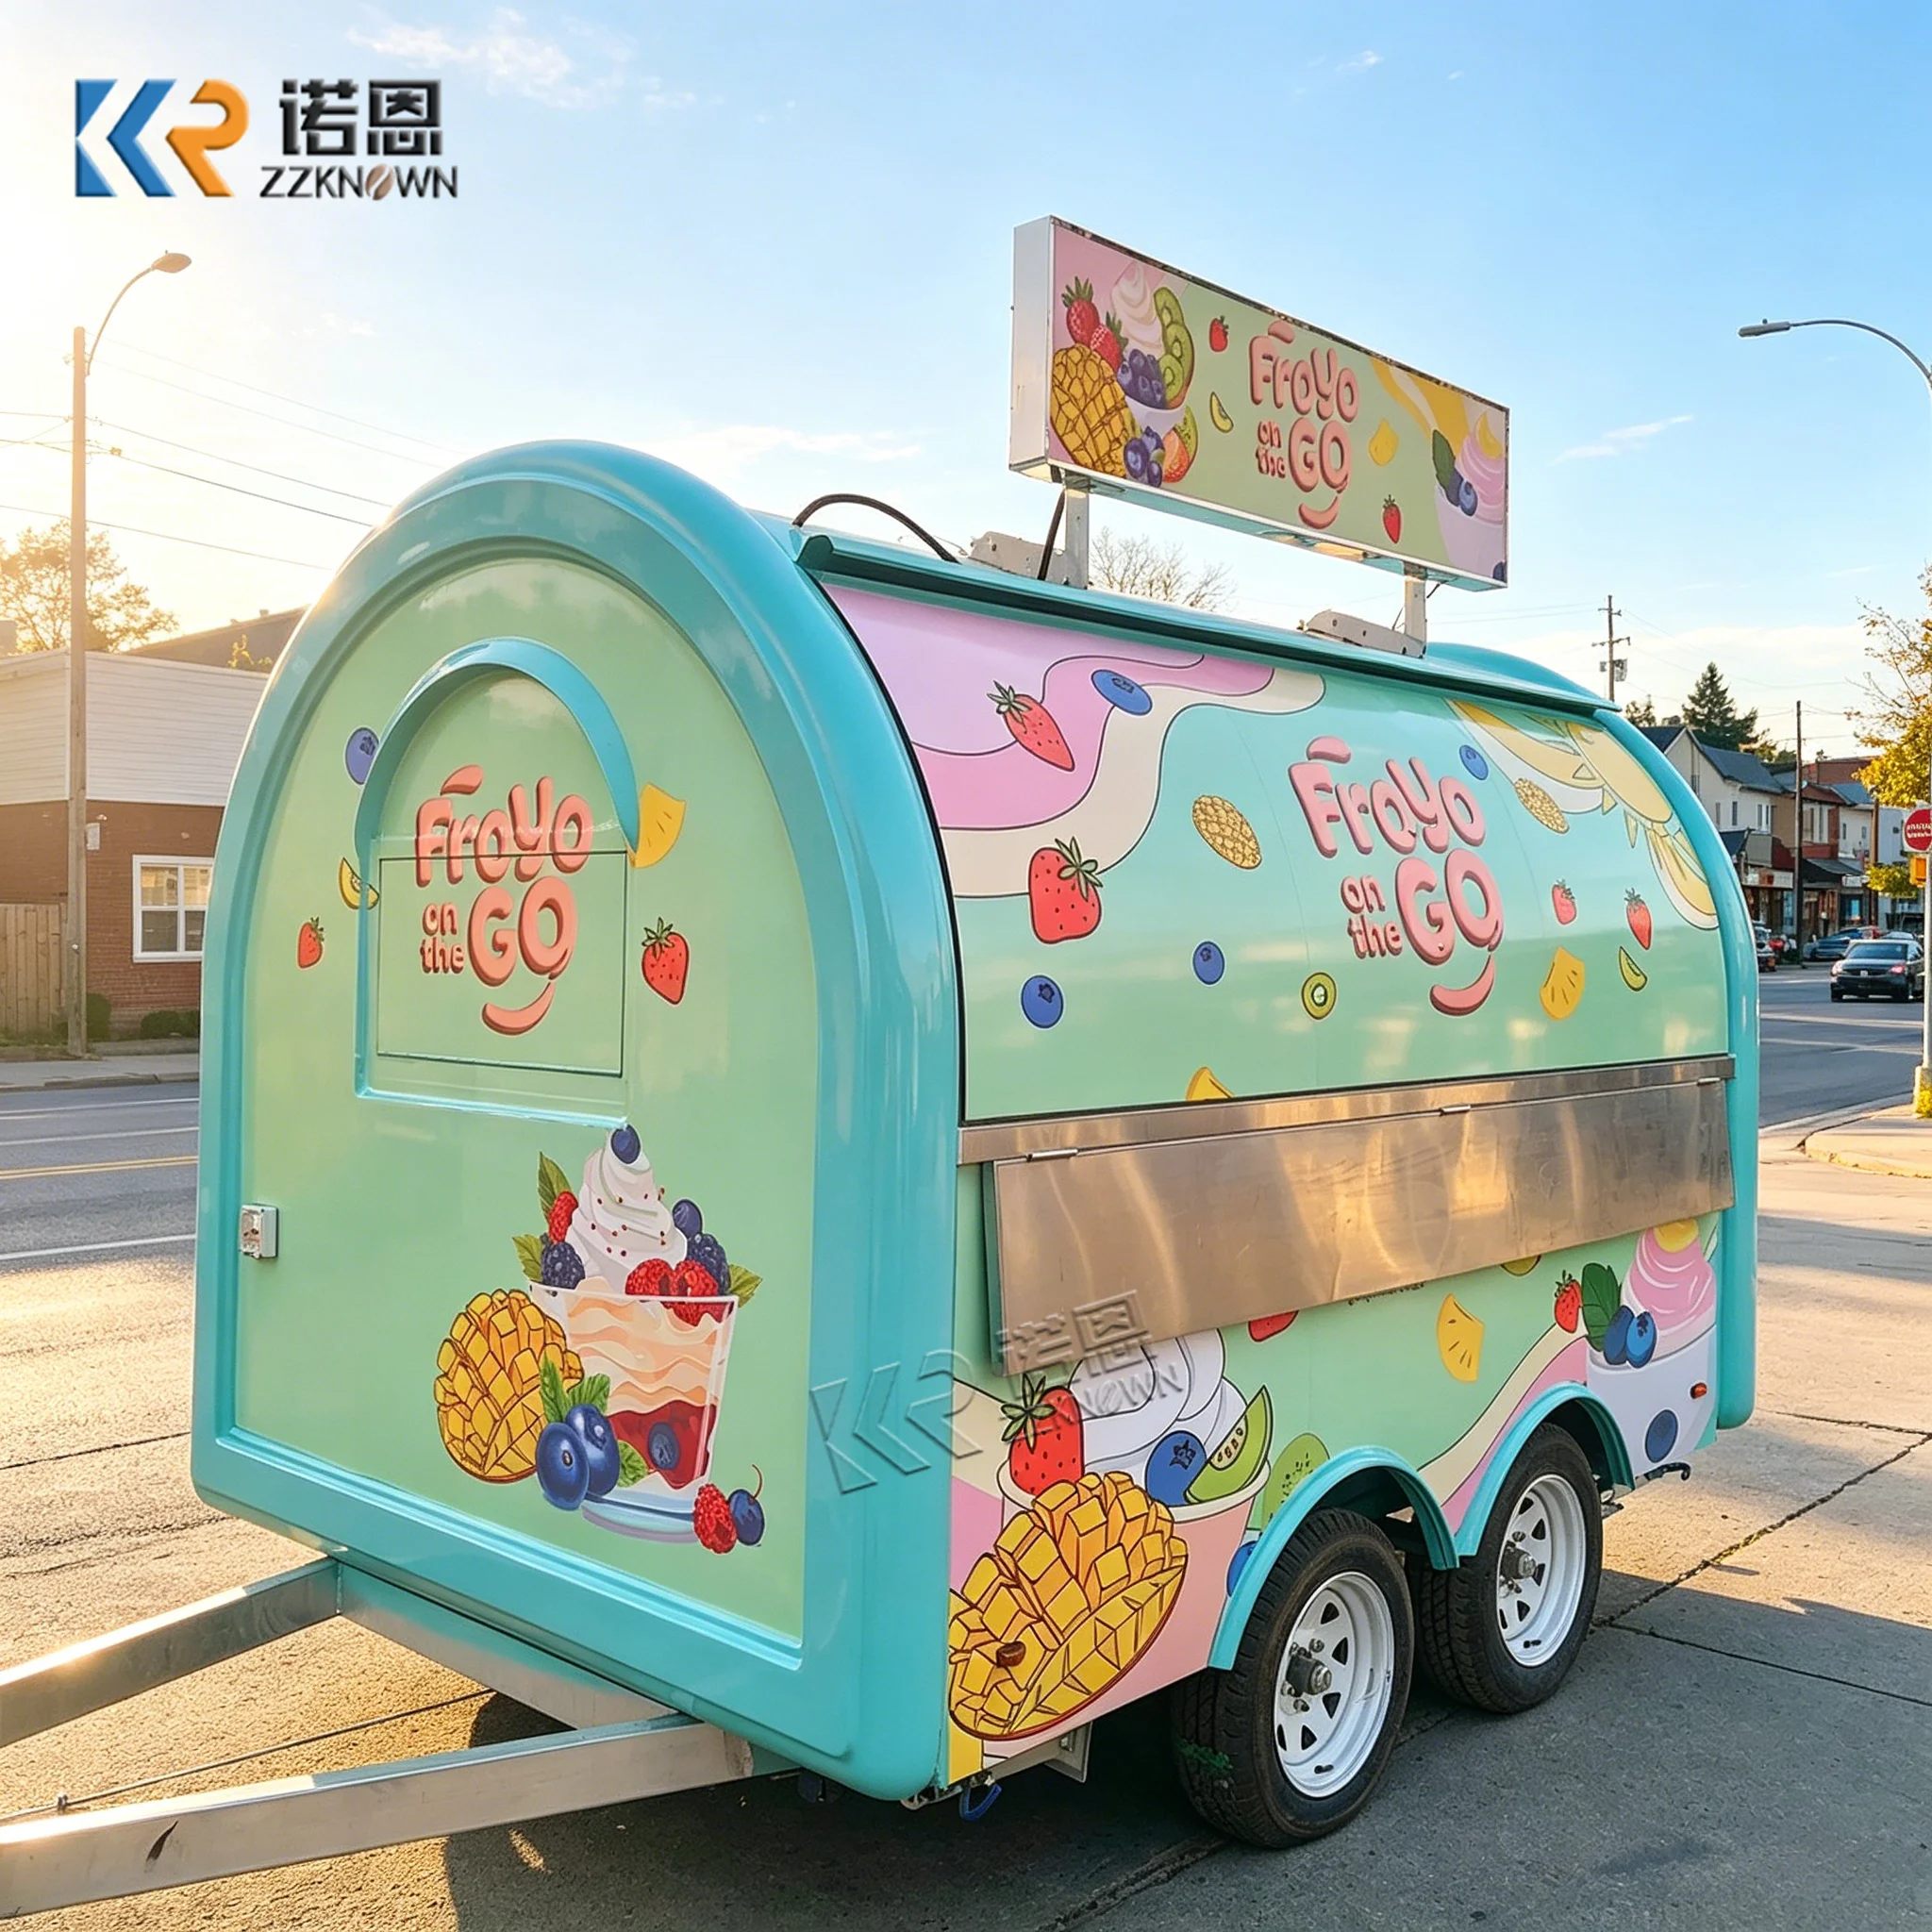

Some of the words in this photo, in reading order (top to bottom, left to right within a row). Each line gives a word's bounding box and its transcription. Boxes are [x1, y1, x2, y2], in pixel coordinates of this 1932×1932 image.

[1289, 417, 1352, 493] GO
[420, 937, 465, 974] the
[468, 875, 578, 987] GO
[422, 903, 458, 936] on
[1341, 875, 1386, 914] on
[1347, 914, 1403, 959] the
[1395, 848, 1504, 966] GO
